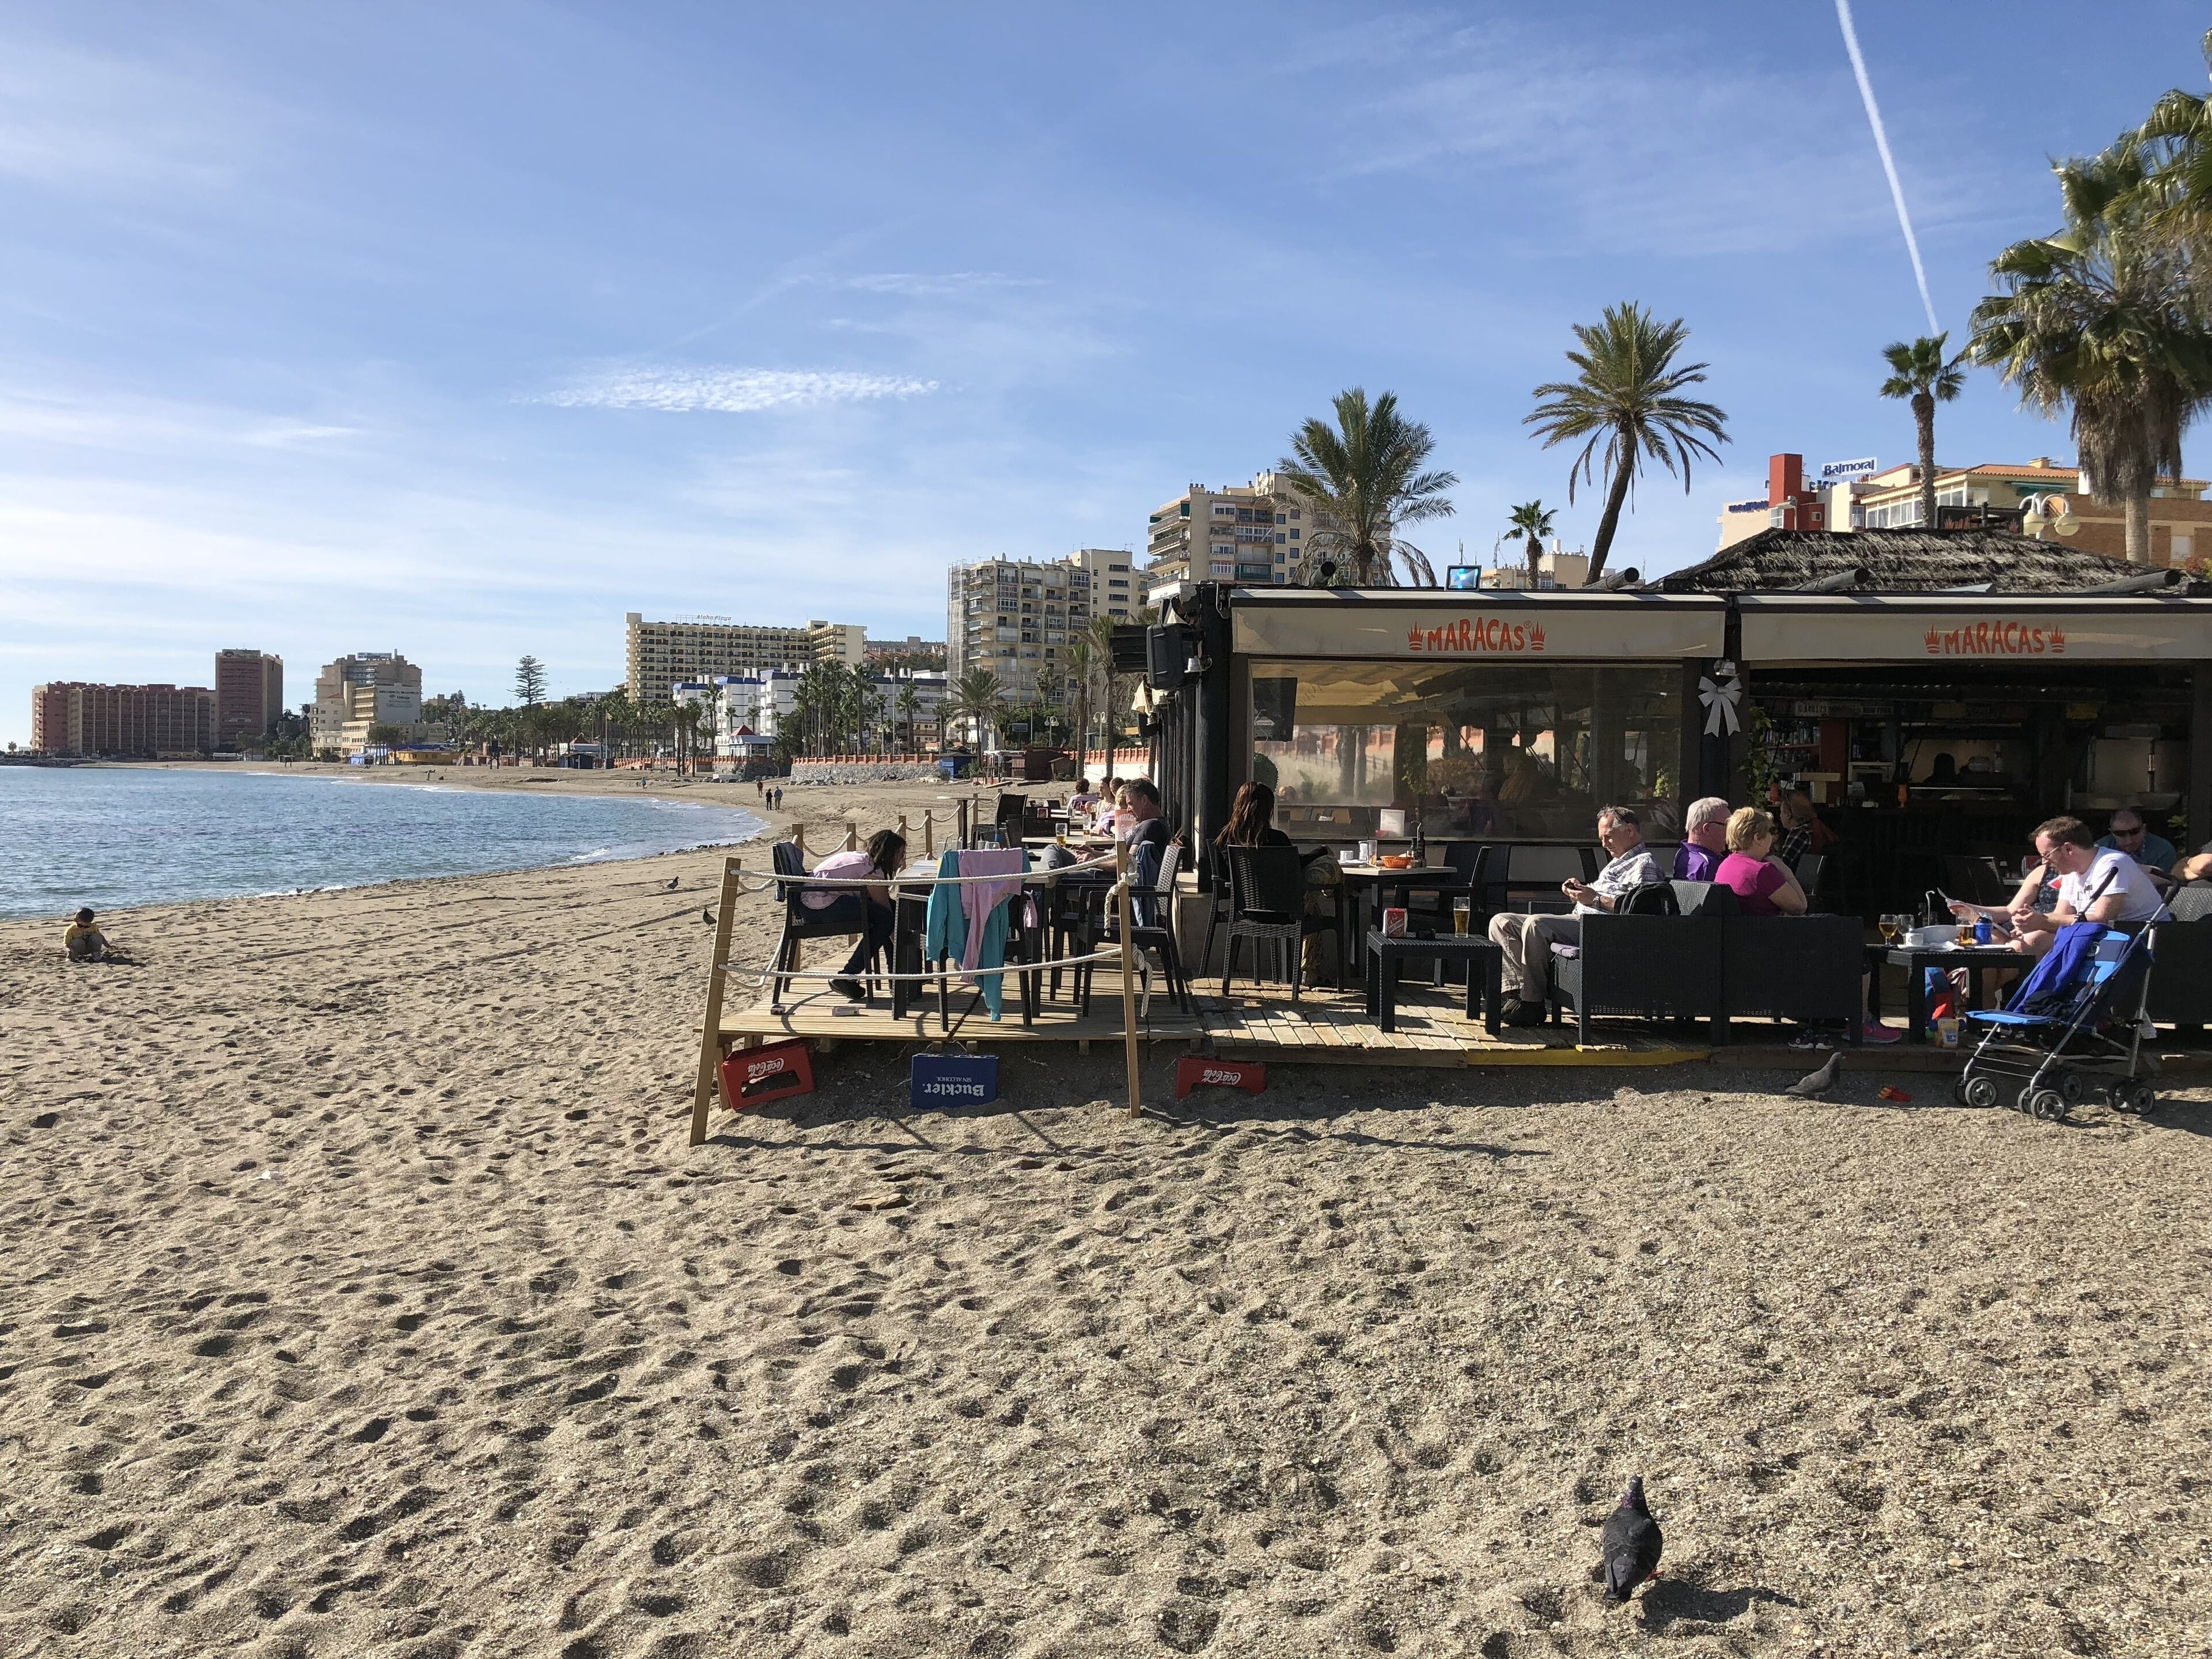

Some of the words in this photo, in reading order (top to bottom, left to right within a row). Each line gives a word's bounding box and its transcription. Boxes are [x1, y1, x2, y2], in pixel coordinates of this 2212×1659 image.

[1824, 459, 1874, 476] Balmoral
[1427, 617, 1525, 651] MARACAS
[1944, 620, 2045, 654] MARACAS
[747, 1058, 784, 1078] Coca-Cola
[1201, 1069, 1241, 1085] Coca-Cola
[923, 1083, 985, 1097] Buckler
